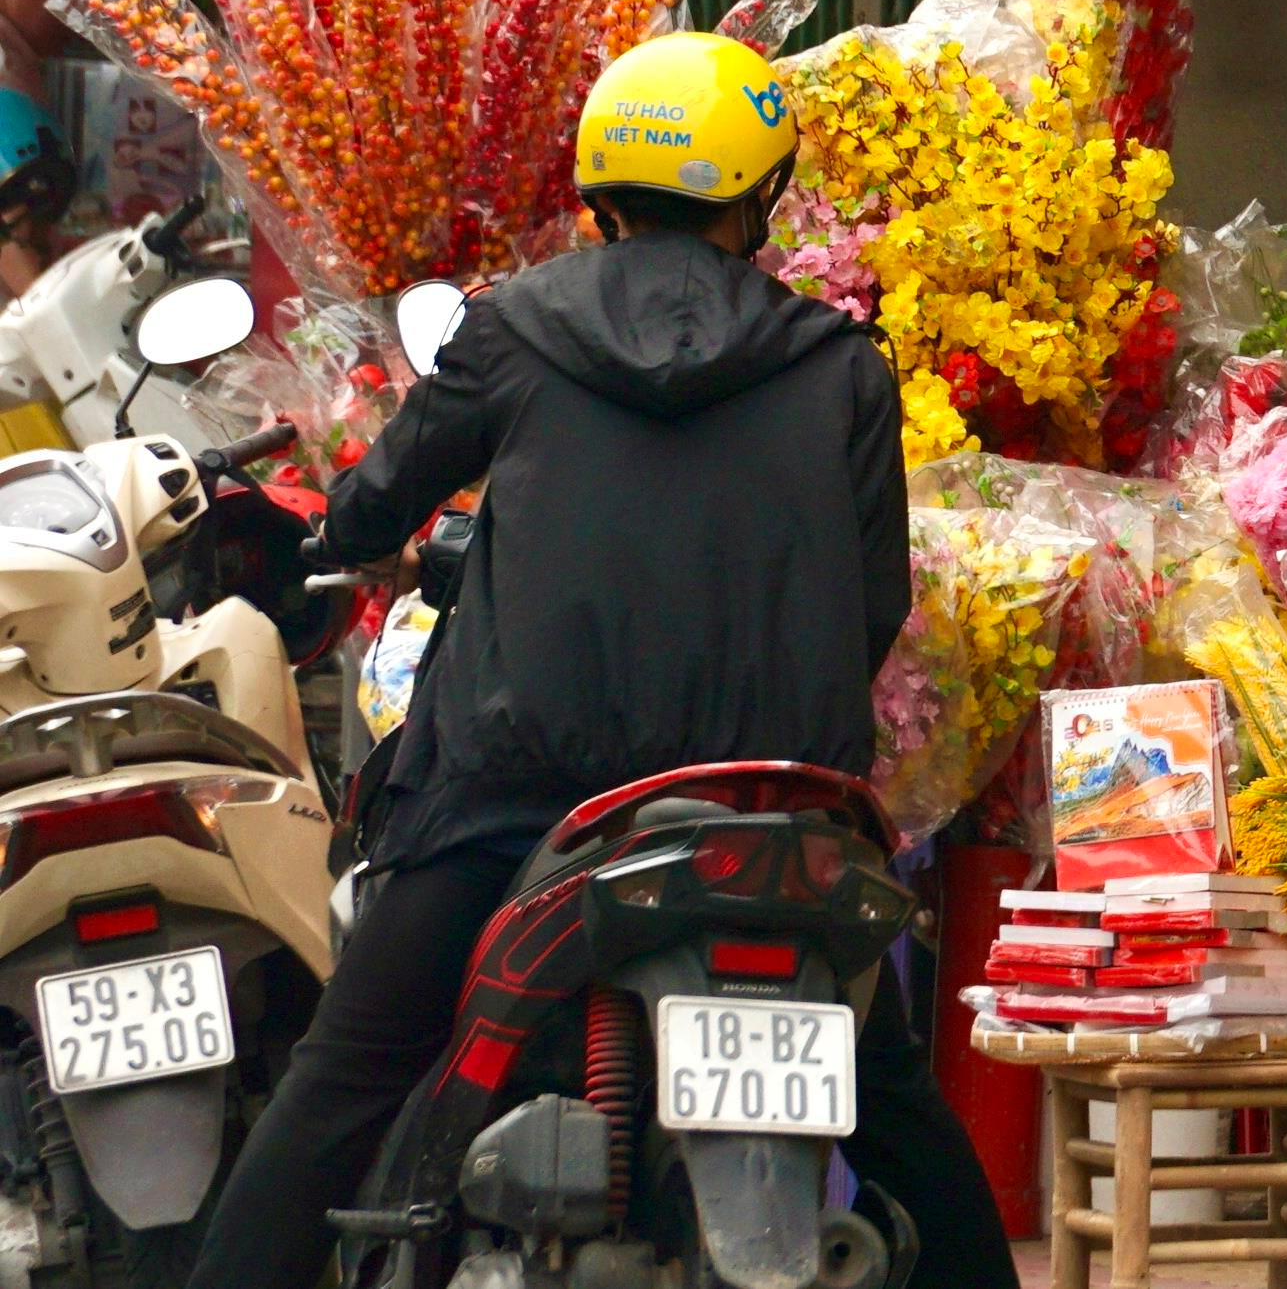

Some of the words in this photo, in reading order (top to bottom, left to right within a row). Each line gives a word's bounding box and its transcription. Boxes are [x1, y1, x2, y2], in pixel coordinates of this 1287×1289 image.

[604, 124, 640, 147] VIỆT
[645, 129, 692, 148] NAM
[616, 102, 639, 122] TỰ
[641, 101, 685, 122] HÀO
[67, 961, 197, 1028] 59-X3
[722, 982, 782, 995] HONDA
[59, 1010, 222, 1086] 275.06
[694, 1009, 824, 1067] 18-B2
[673, 1068, 841, 1125] 670.01
